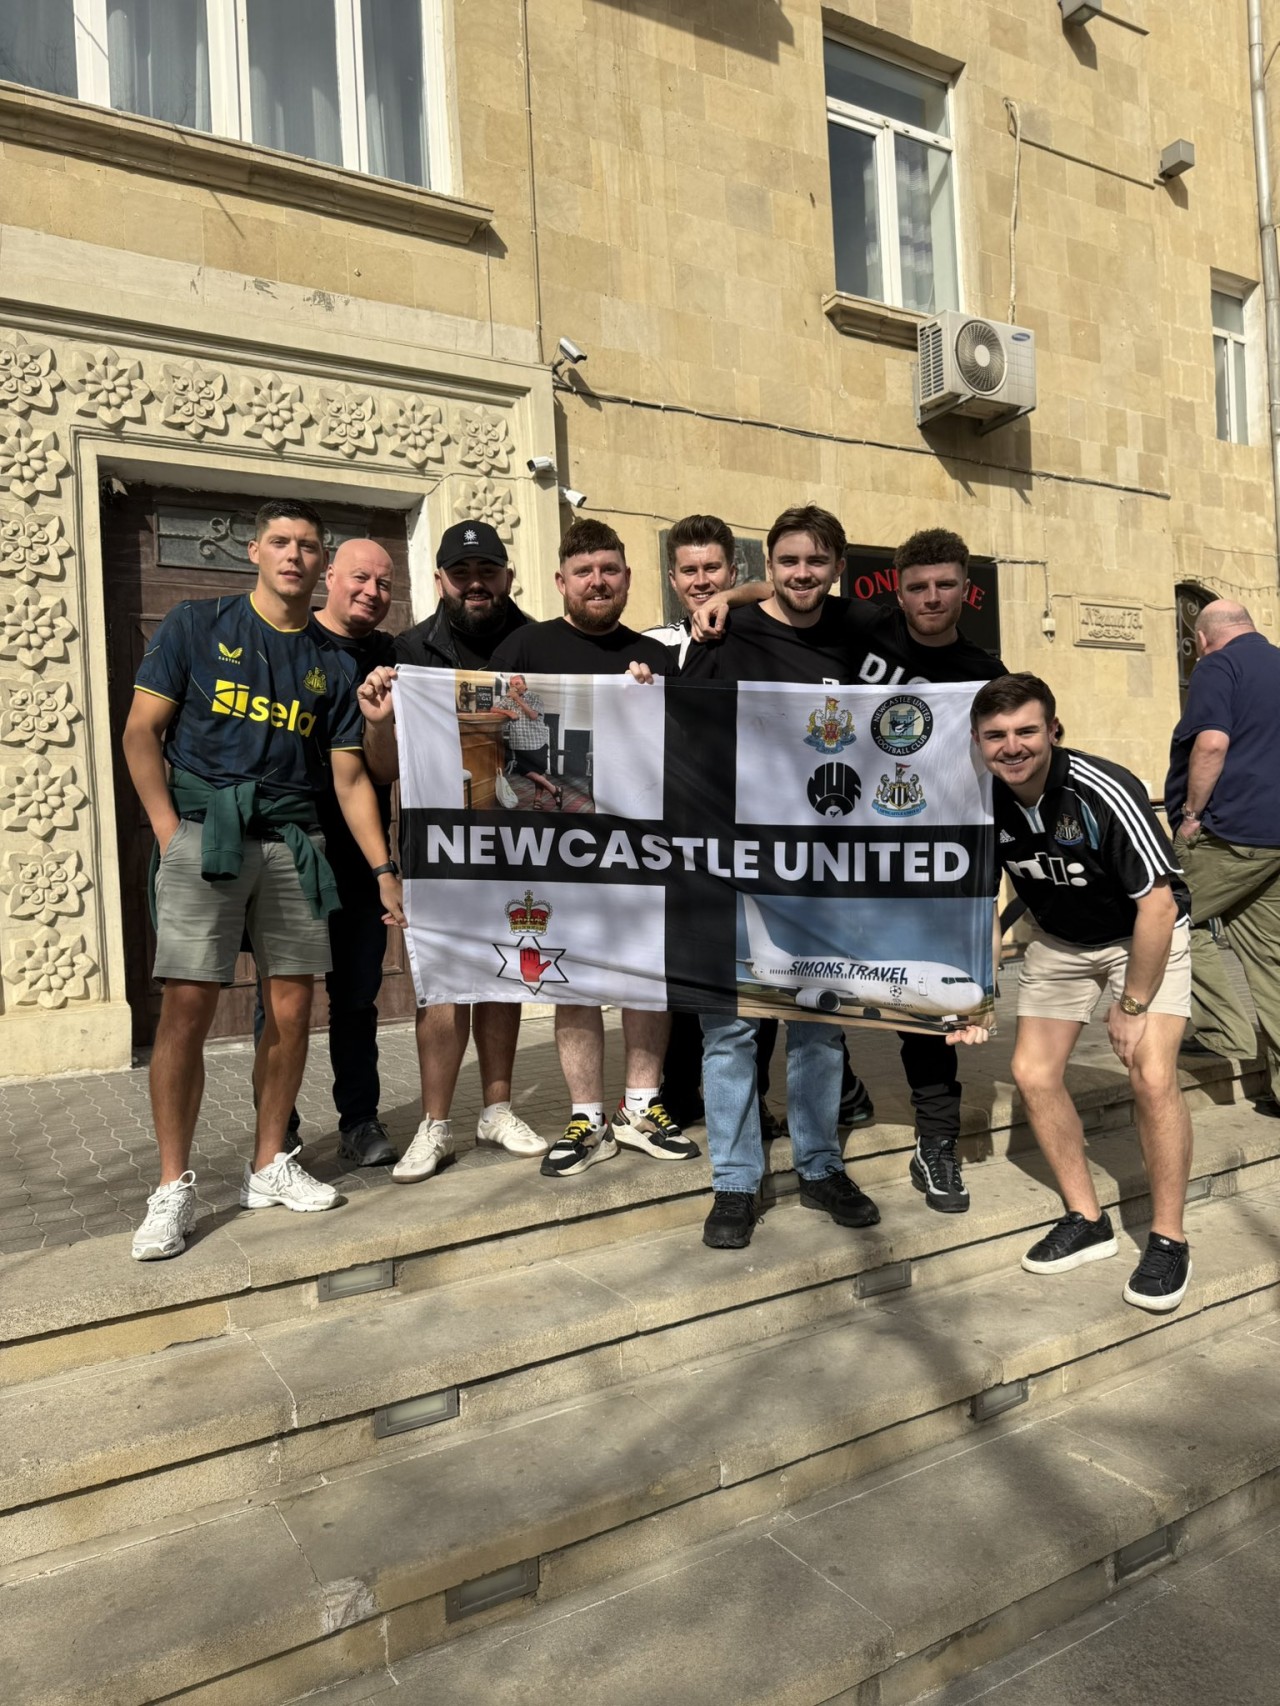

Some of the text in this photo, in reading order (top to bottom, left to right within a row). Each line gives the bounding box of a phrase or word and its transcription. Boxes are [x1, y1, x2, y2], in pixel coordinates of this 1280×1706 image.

[249, 696, 317, 738] sela
[873, 696, 931, 722] NEWCASTLE UNITED
[875, 734, 928, 754] FOOTBALL CLUB
[426, 824, 970, 883] NEWCASTLE UNITED
[789, 960, 907, 982] SIMONS TRAVEL
